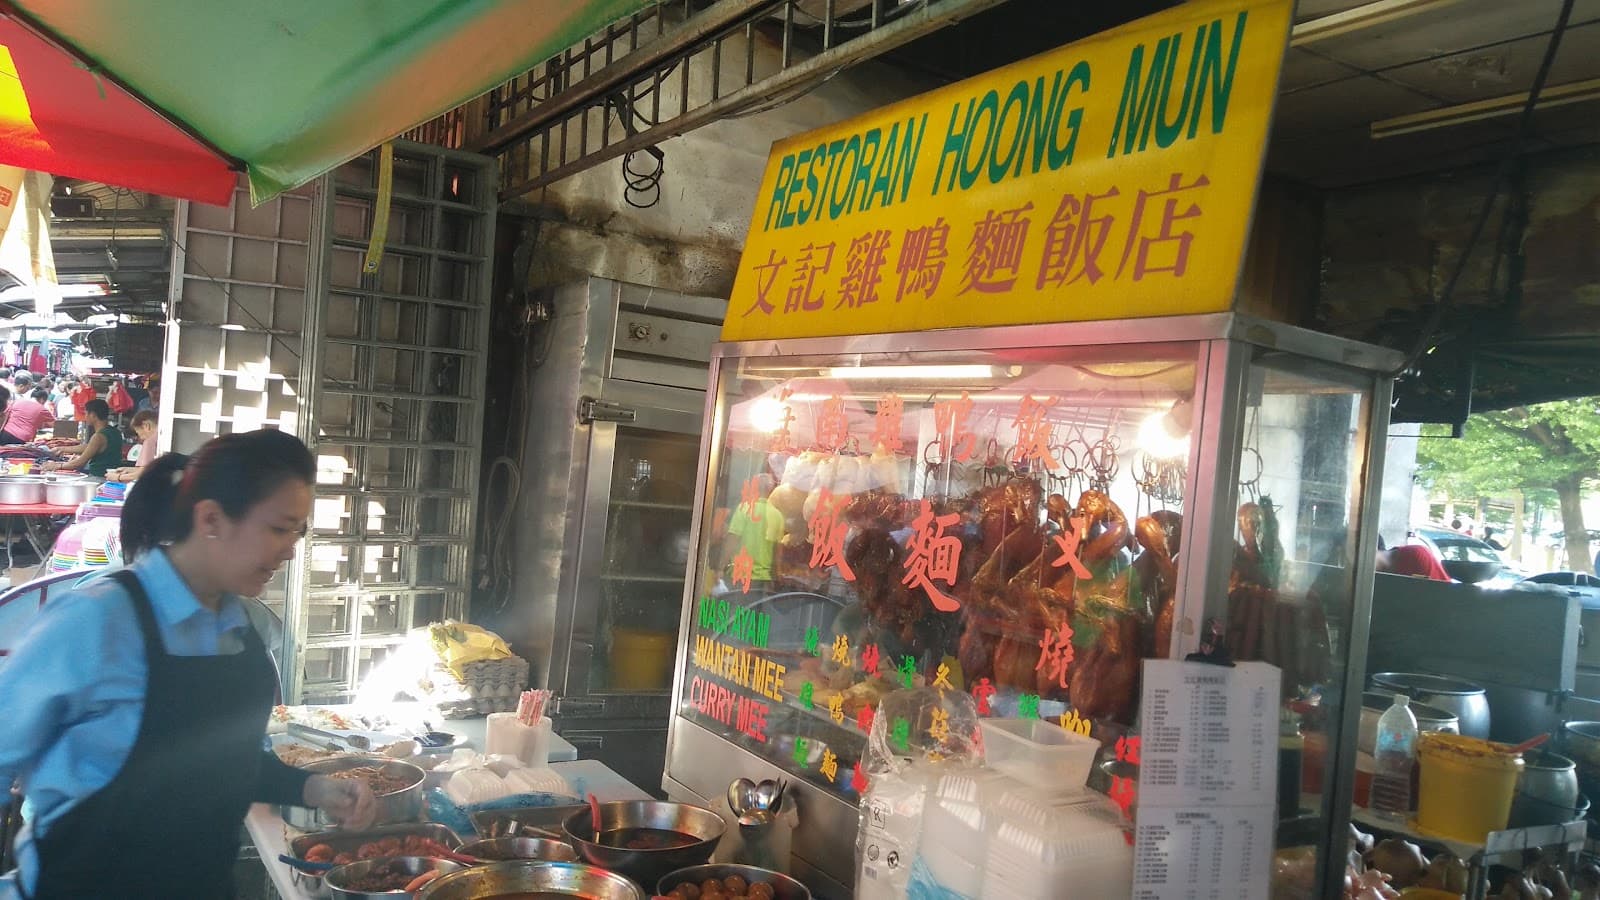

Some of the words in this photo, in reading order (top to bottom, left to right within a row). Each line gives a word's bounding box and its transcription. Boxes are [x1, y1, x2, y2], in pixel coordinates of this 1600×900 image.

[764, 113, 928, 232] RESTORAN
[931, 61, 1091, 195] HOONG
[1109, 12, 1247, 159] MUN
[741, 173, 1210, 319] 文記雞鴨麵飯店
[699, 597, 730, 635] NASI
[731, 605, 771, 649] AYAM
[695, 634, 751, 688] WANTAN
[751, 656, 786, 703] MEE
[690, 675, 736, 726] CURRY
[736, 695, 770, 743] MEE
